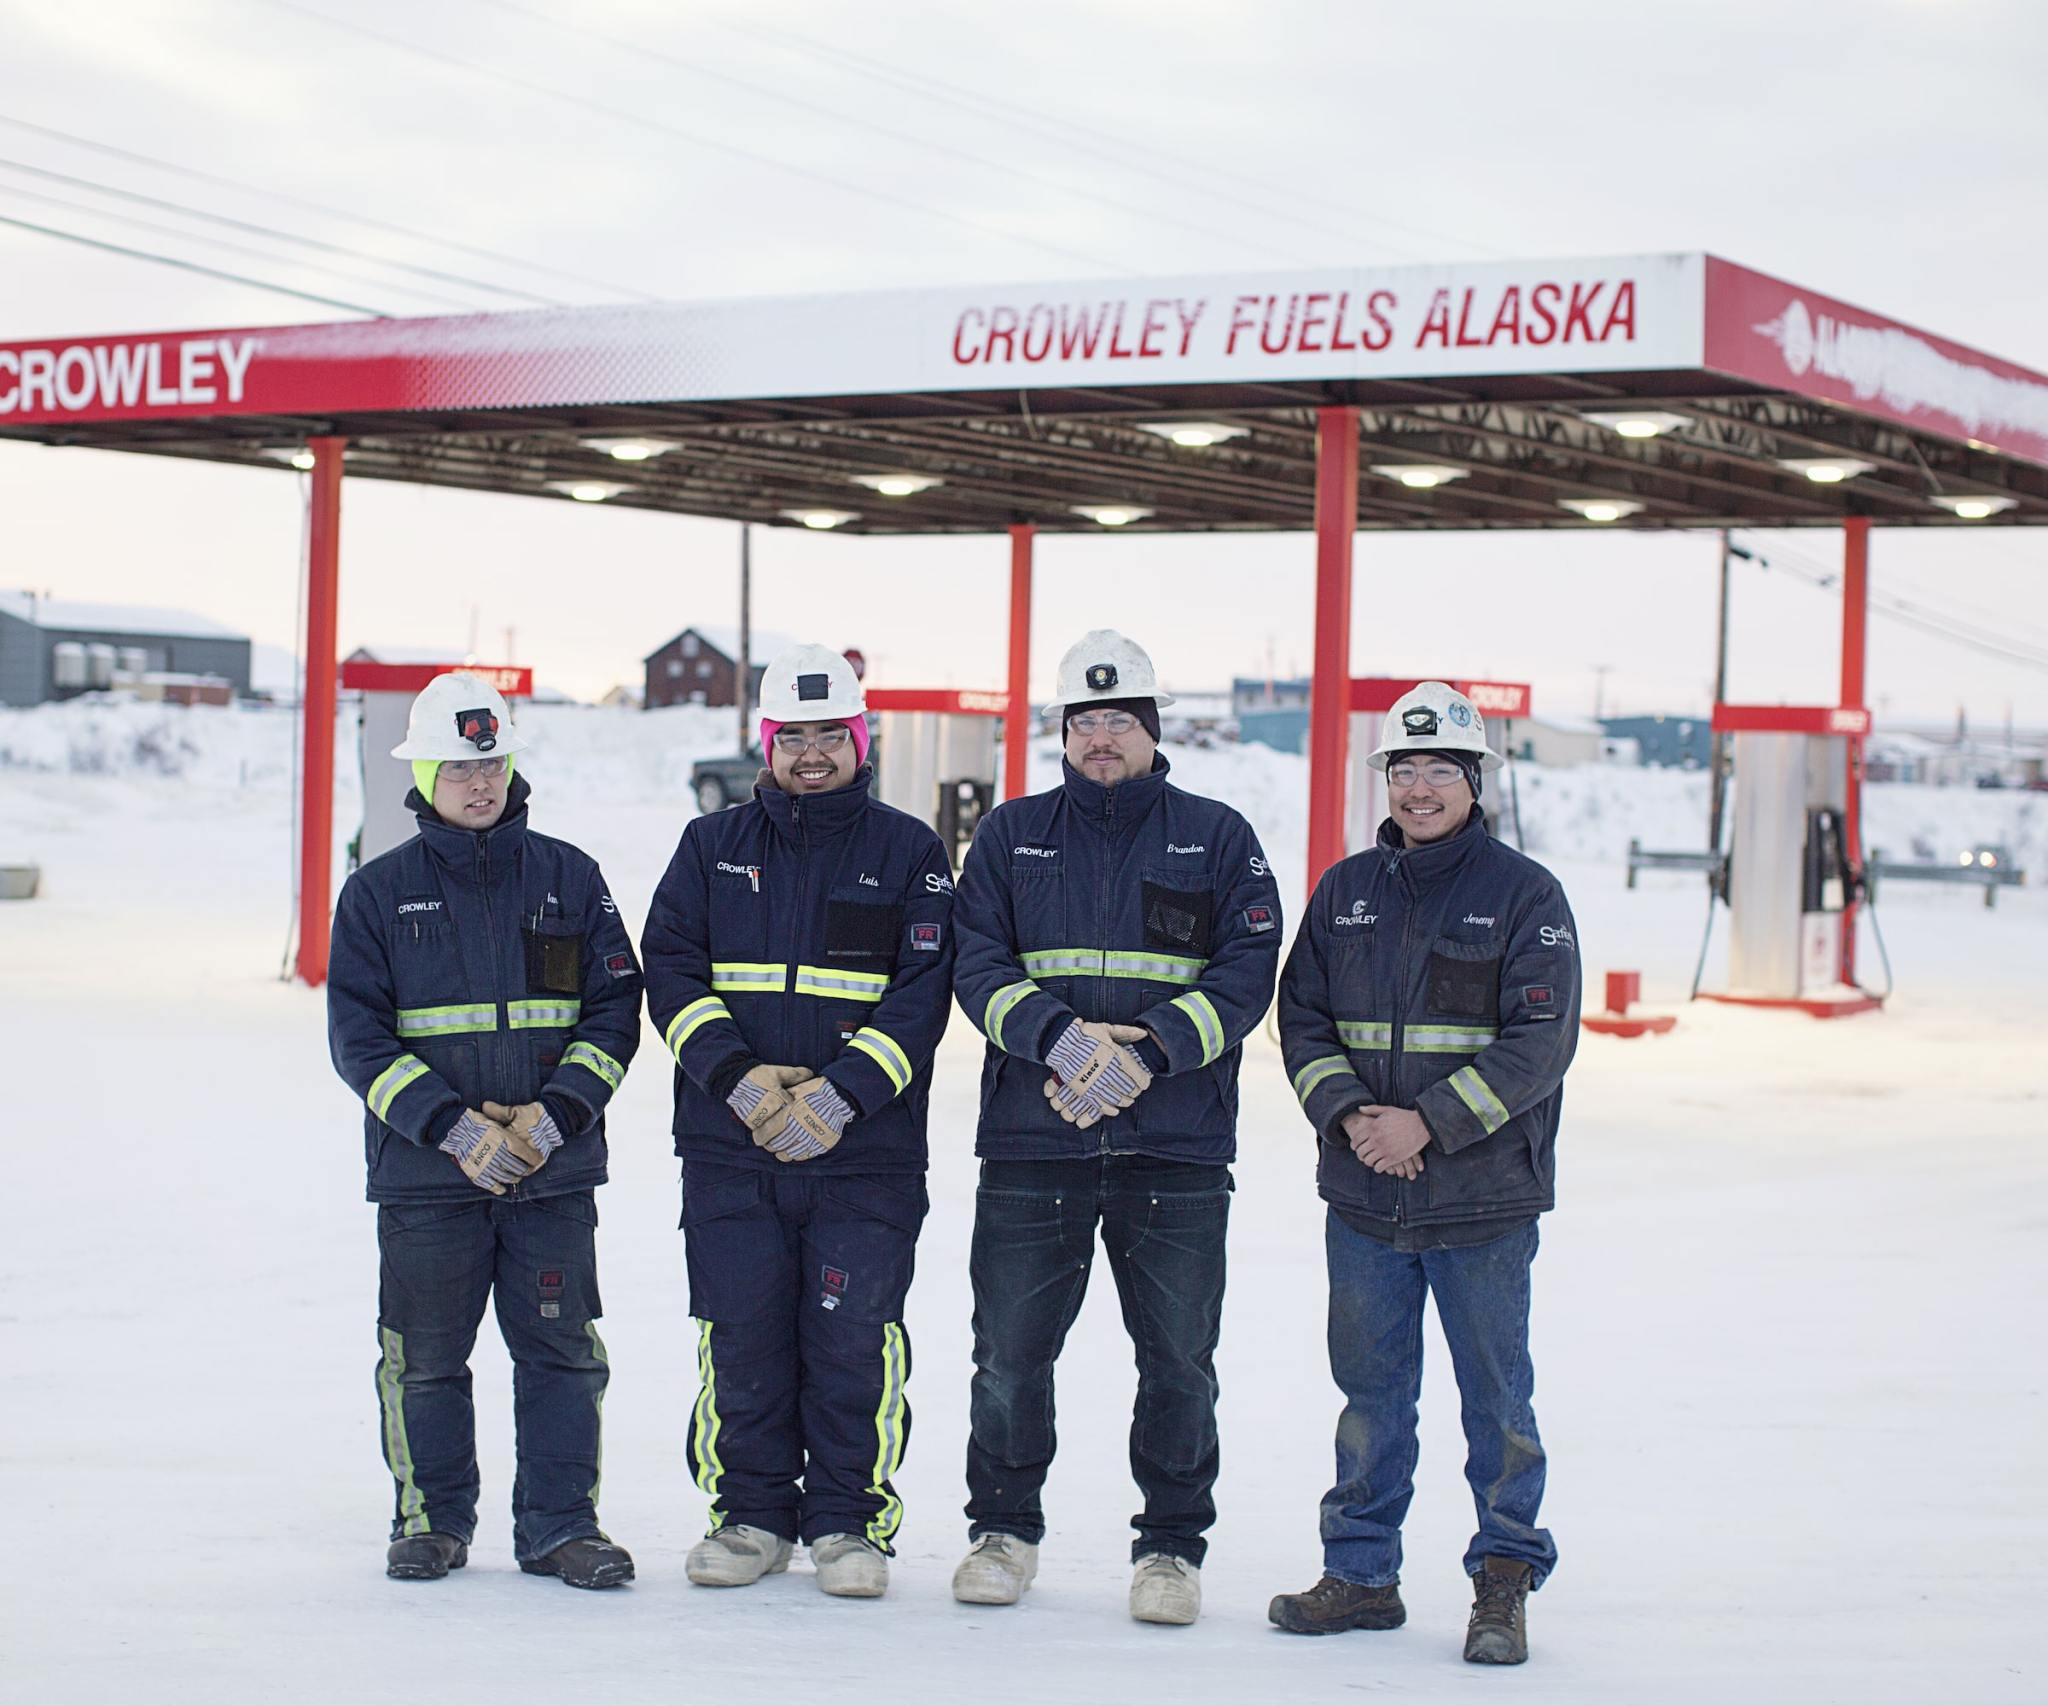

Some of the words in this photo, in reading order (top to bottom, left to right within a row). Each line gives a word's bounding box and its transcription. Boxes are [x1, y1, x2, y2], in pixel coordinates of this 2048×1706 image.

[952, 297, 1205, 365] CROWLEY
[1225, 289, 1396, 355] FUELS
[1415, 279, 1636, 349] ALASKA
[0, 338, 255, 414] CROWLEY
[1014, 846, 1056, 858] CROWLEY
[1167, 843, 1205, 854] Brandon
[859, 873, 879, 887] Luis
[398, 901, 441, 914] CROWLEY
[1335, 915, 1377, 925] CROWLEY
[1463, 912, 1495, 928] Jeremy
[918, 929, 934, 940] FR
[1079, 1060, 1100, 1084] Kinco
